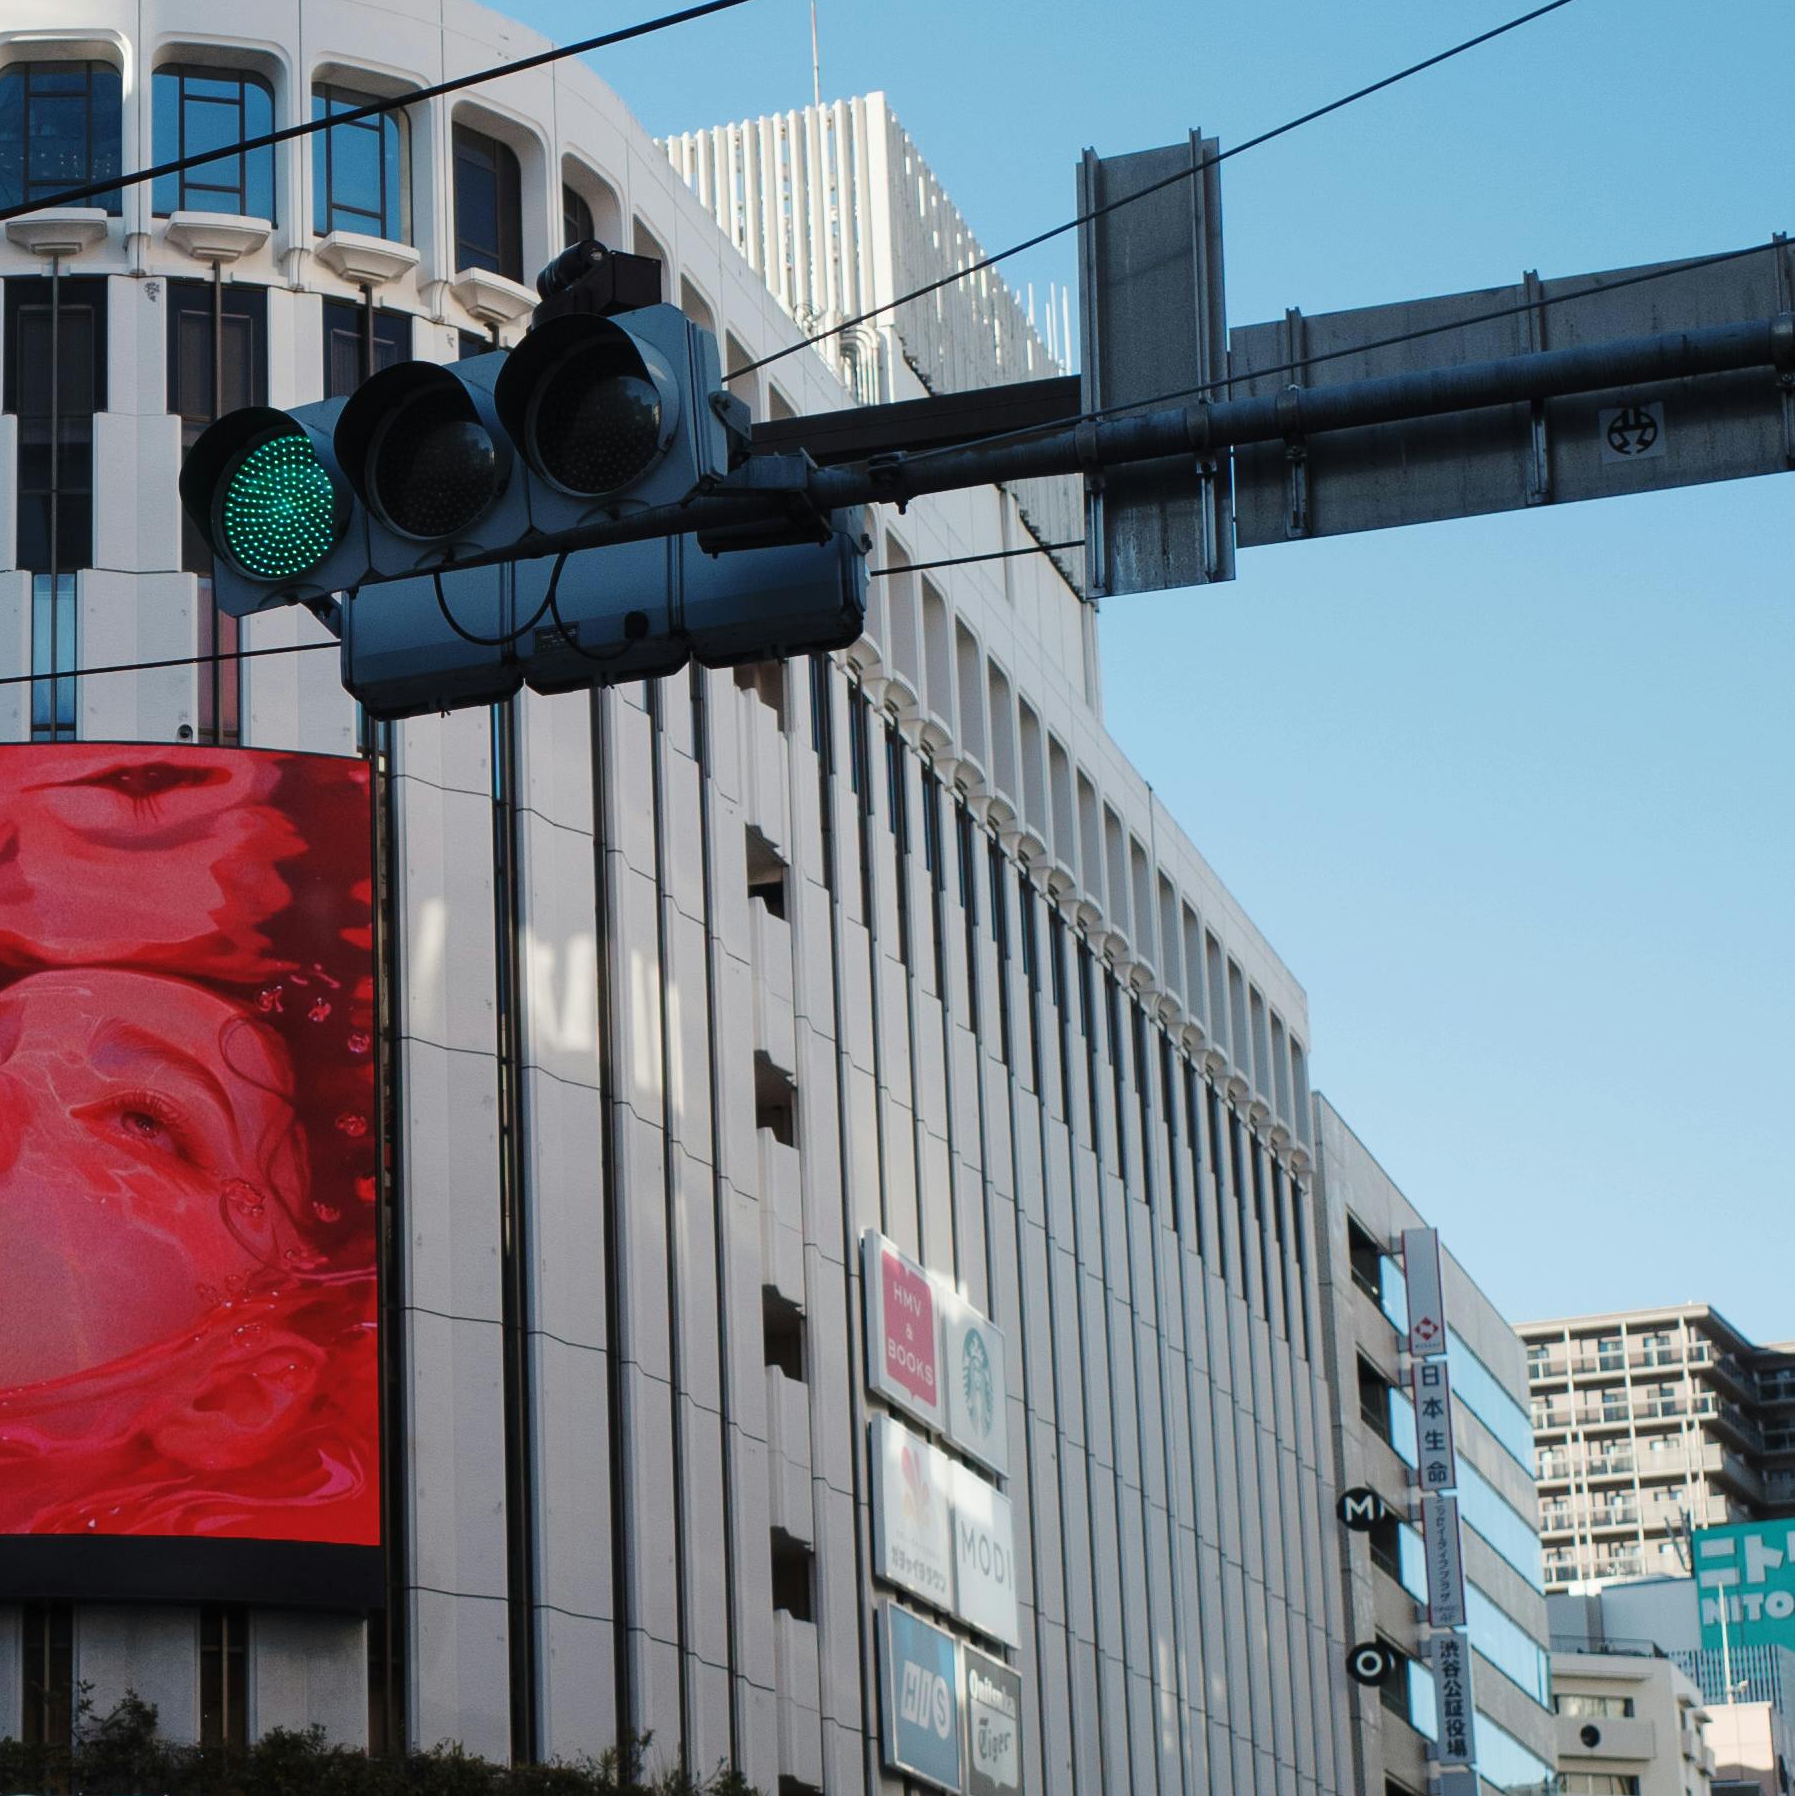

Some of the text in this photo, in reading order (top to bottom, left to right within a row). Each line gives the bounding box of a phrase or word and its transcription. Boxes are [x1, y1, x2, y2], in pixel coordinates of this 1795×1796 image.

[892, 1281, 923, 1317] HMV
[887, 1337, 934, 1387] BOOKS
[1422, 1364, 1448, 1484] 日本生命
[960, 1520, 1012, 1590] MODI
[1440, 1639, 1468, 1757] 渋谷公証役場
[978, 1717, 1012, 1762] Tiger
